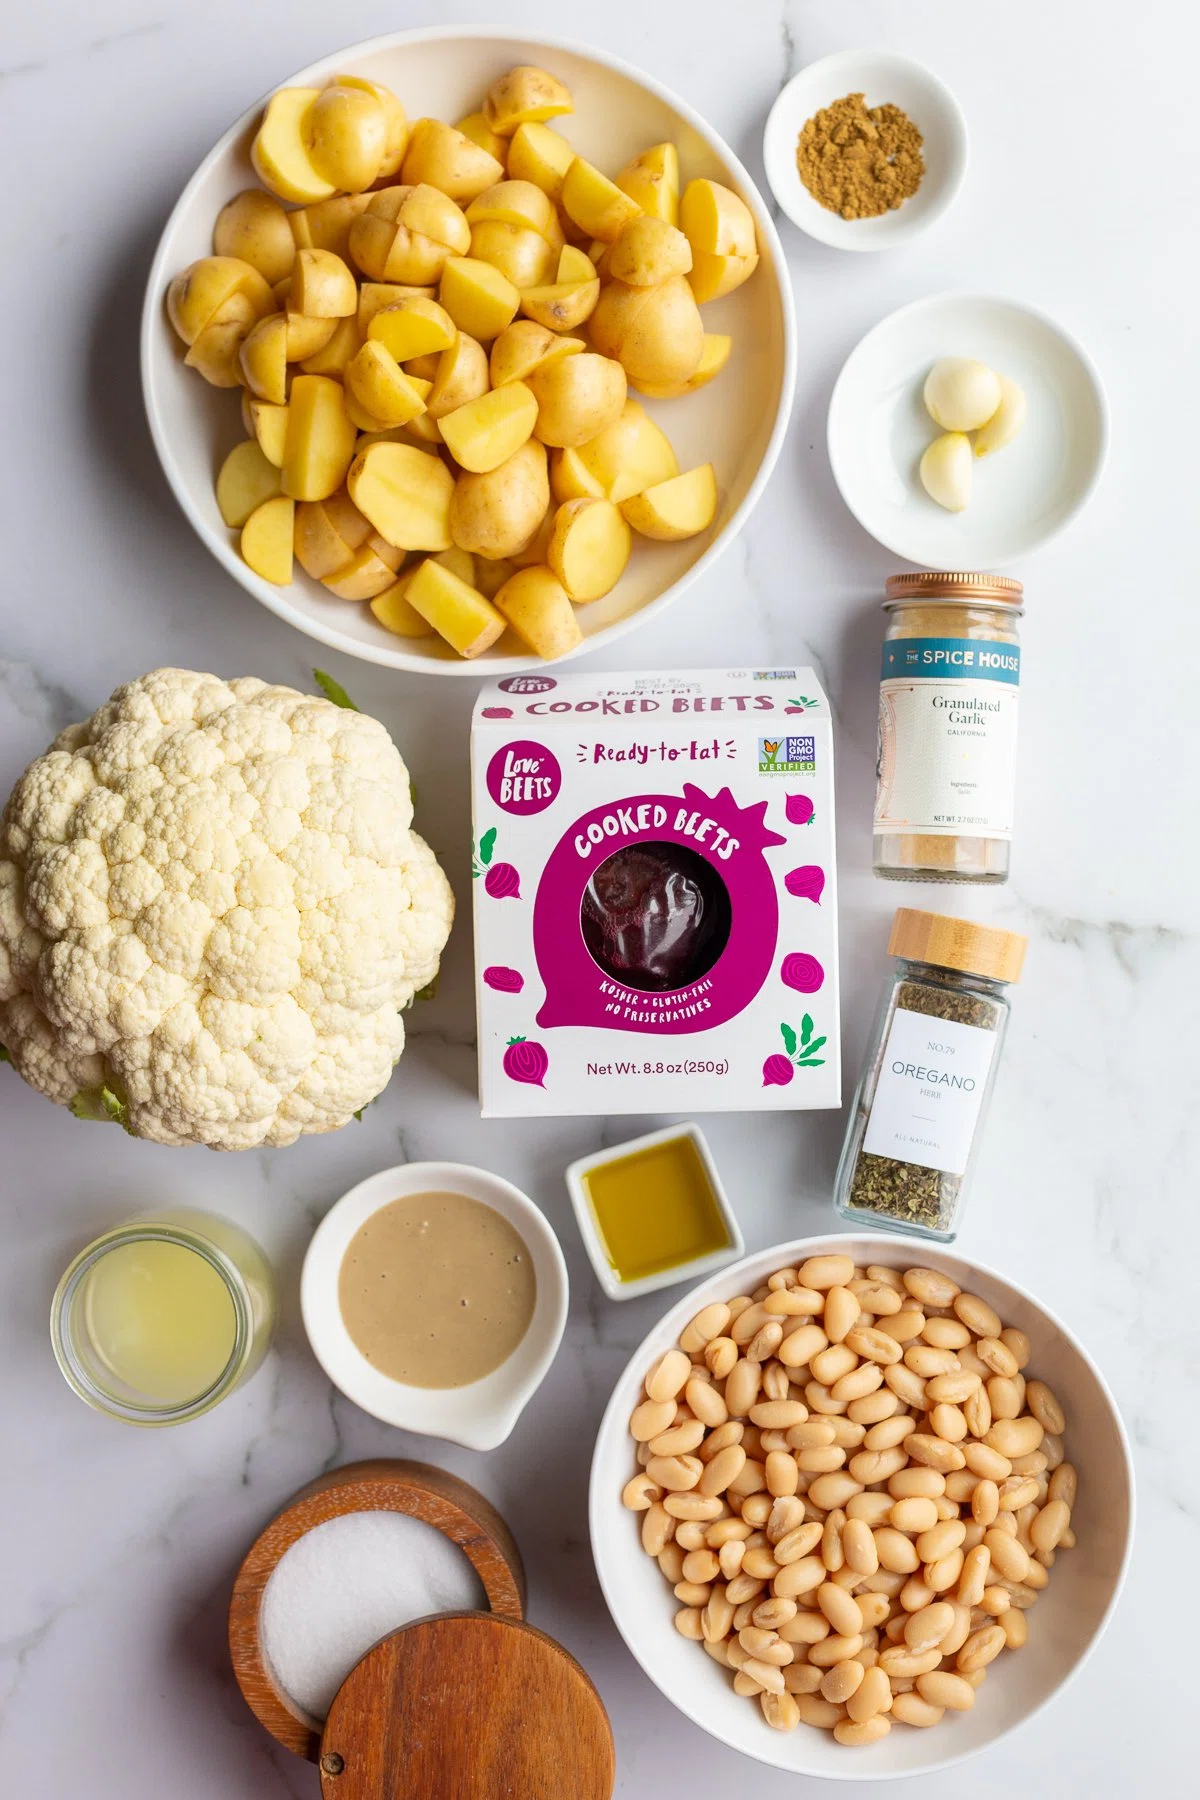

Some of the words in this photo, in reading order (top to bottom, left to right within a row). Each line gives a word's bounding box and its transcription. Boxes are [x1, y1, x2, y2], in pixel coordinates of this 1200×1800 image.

[923, 650, 974, 666] SPICE
[978, 651, 1019, 672] HOUSE
[508, 683, 550, 693] BEETS
[525, 698, 660, 715] COOKED
[672, 695, 774, 713] BEETS
[932, 695, 1001, 713] Granulated
[948, 711, 986, 725] Garlic
[947, 729, 986, 737] CALIFORNIA
[789, 738, 813, 746] NON
[789, 746, 814, 755] GMO
[594, 739, 720, 764] Ready-to-Eat
[789, 753, 814, 762] Project
[504, 750, 539, 778] Love
[761, 763, 814, 771] VERIFIED
[500, 777, 552, 804] BEETS
[574, 804, 668, 858] COOKED
[673, 808, 740, 860] BEETS
[599, 980, 639, 1005] KOSHER
[652, 978, 713, 1008] GLUTEN-FREE
[605, 1003, 621, 1015] NO
[624, 998, 712, 1023] PRESERVATIVES
[927, 1041, 956, 1056] NO.79
[587, 1063, 612, 1075] Net
[615, 1062, 641, 1074] Wt.
[643, 1062, 664, 1074] 8.8
[891, 1060, 976, 1092] OREGANO
[919, 1087, 942, 1099] HERB
[893, 1132, 908, 1143] ALL
[909, 1136, 941, 1149] NATURAL
